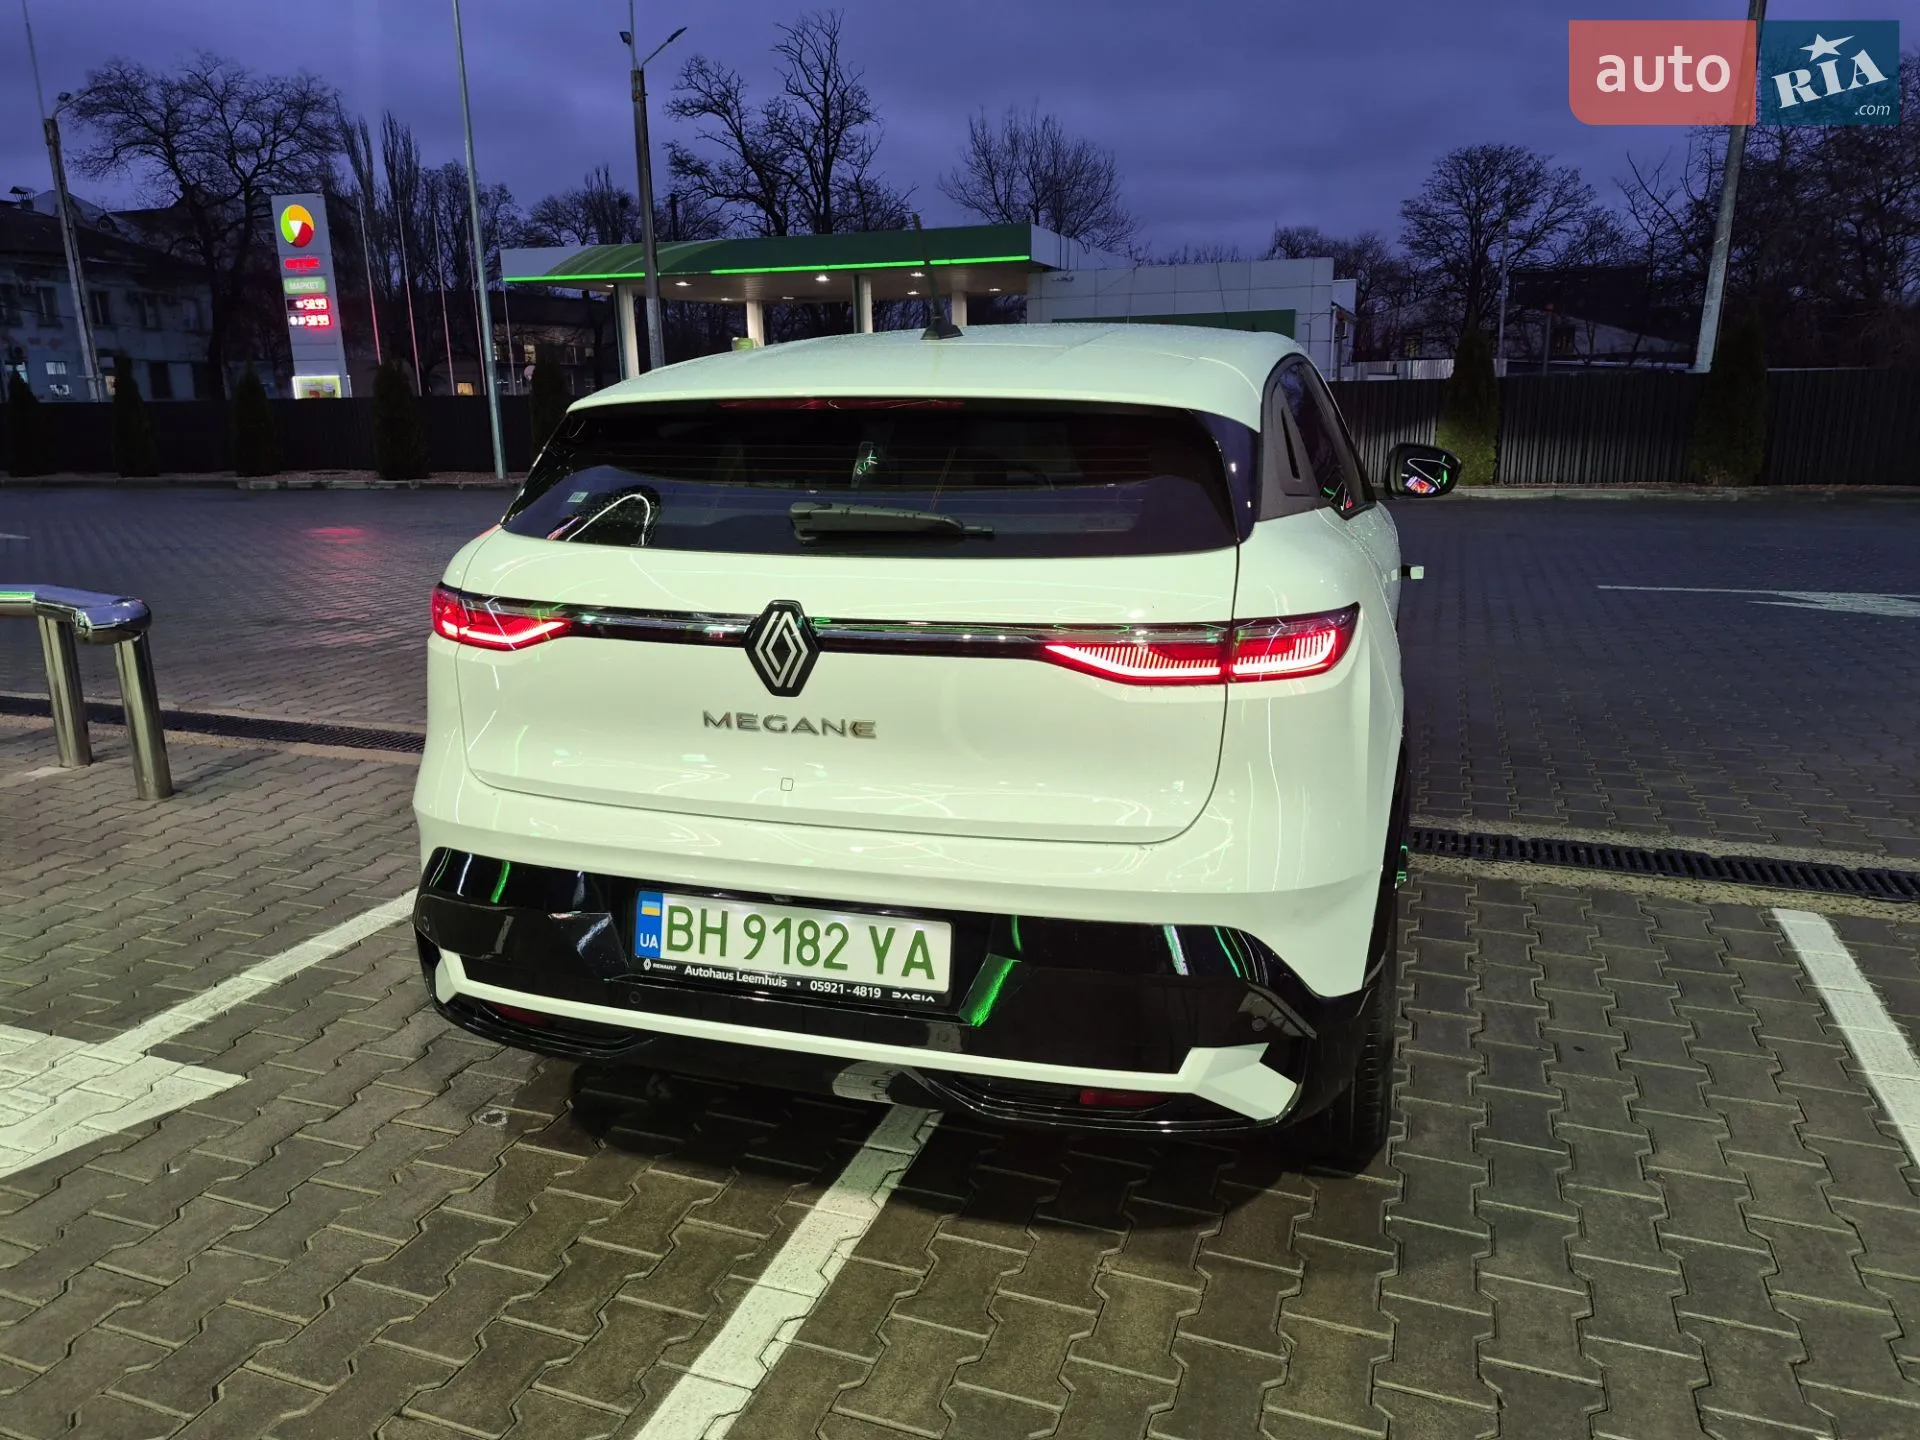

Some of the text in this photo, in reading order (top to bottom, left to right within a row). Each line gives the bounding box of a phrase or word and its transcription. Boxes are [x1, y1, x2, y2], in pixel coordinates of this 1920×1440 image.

[702, 710, 877, 739] MEGANE
[639, 932, 659, 949] UA
[666, 905, 936, 980] BH 9182 YA
[652, 963, 677, 972] RENAULT
[684, 965, 734, 981] Autohaus
[736, 971, 788, 987] Leemhuis
[891, 991, 936, 1003] DACIA
